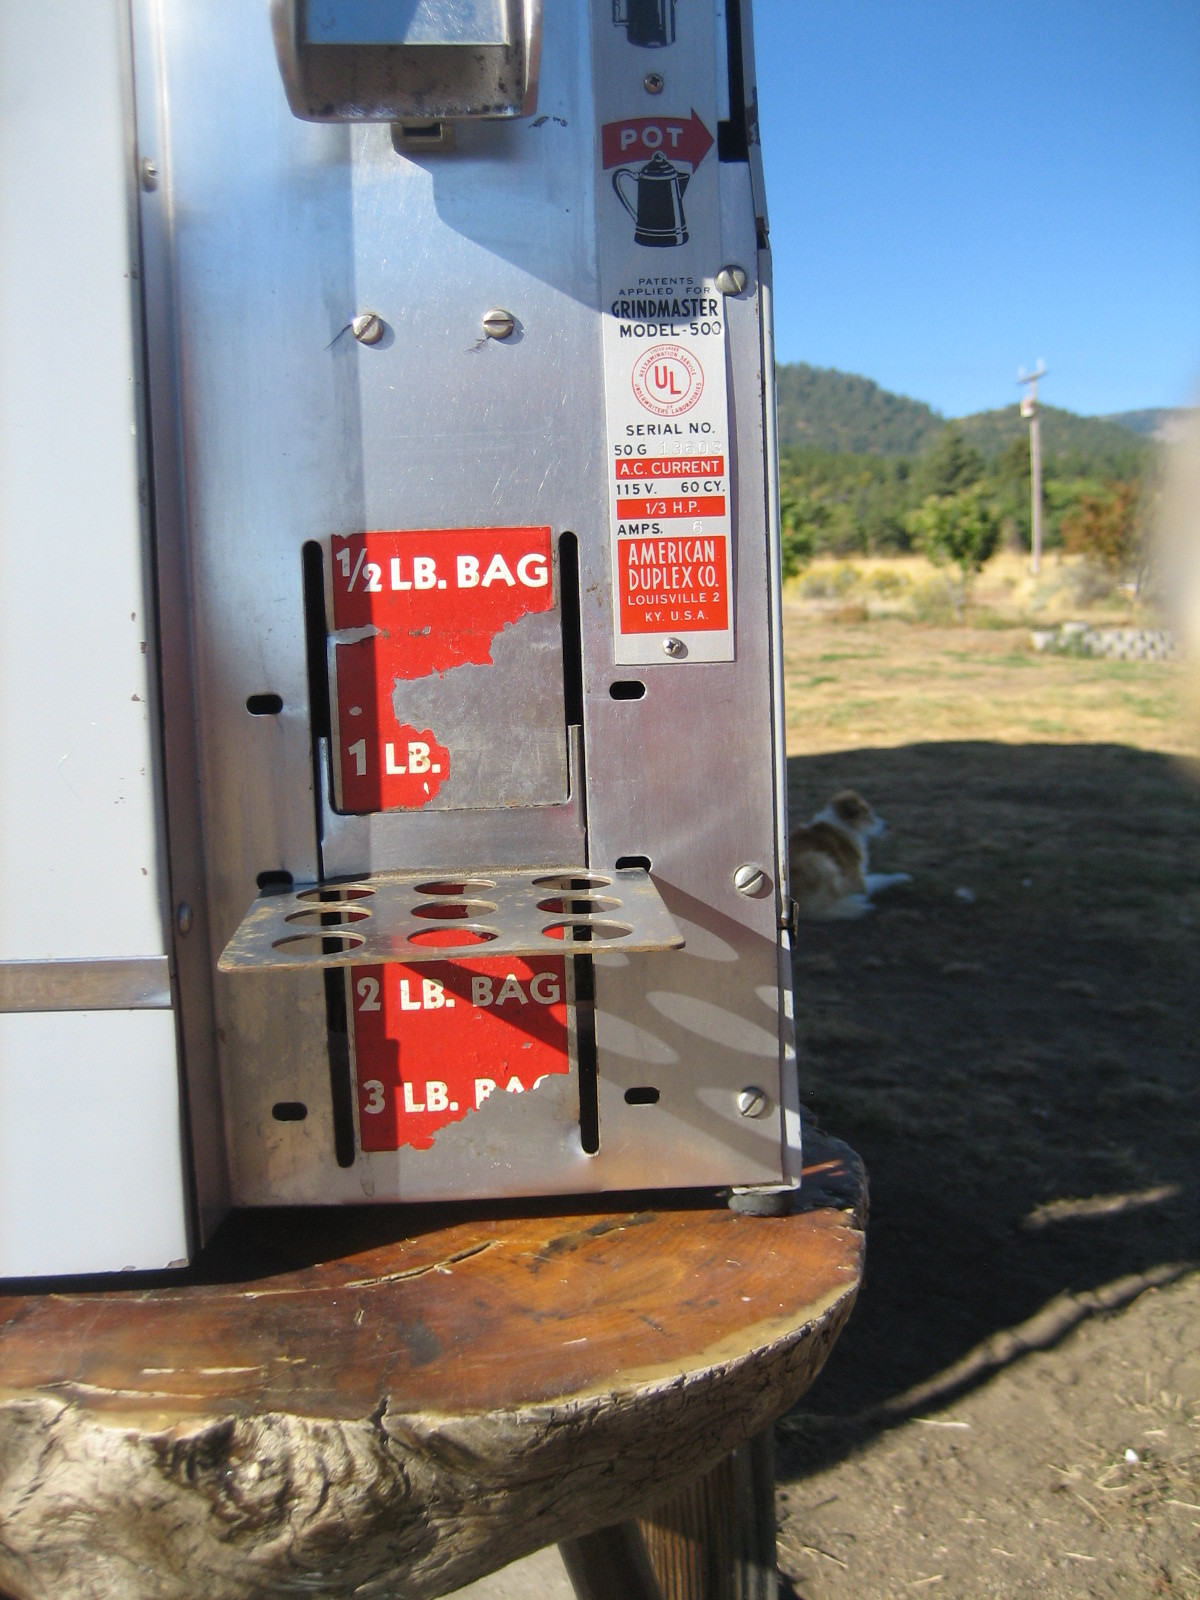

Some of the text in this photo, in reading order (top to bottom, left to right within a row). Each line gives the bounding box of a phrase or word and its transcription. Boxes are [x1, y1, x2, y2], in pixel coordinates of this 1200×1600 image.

[620, 126, 683, 150] POT
[618, 286, 711, 296] APPLIED FOR
[638, 277, 694, 286] PATENTS
[611, 298, 718, 319] GRINDMASTER
[620, 321, 722, 338] MODEL-500
[655, 365, 682, 395] UL
[626, 422, 716, 436] SERIAL NO.
[620, 460, 720, 476] A.C. CURRENT
[645, 500, 701, 515] 1/3 H.P.
[617, 520, 703, 535] AMPS. 6
[628, 540, 715, 566] AMERICAN
[390, 556, 447, 591] LB.
[456, 553, 549, 589] BAG
[628, 565, 719, 591] DUPLEX CO.
[628, 592, 720, 606] LOUISVILLE 2
[645, 610, 709, 622] KY. U.S.A.
[348, 738, 441, 776] 1 LB.
[356, 972, 561, 1012] 2 LB. BAG
[362, 1079, 386, 1115] 3
[403, 1080, 459, 1113] LB.
